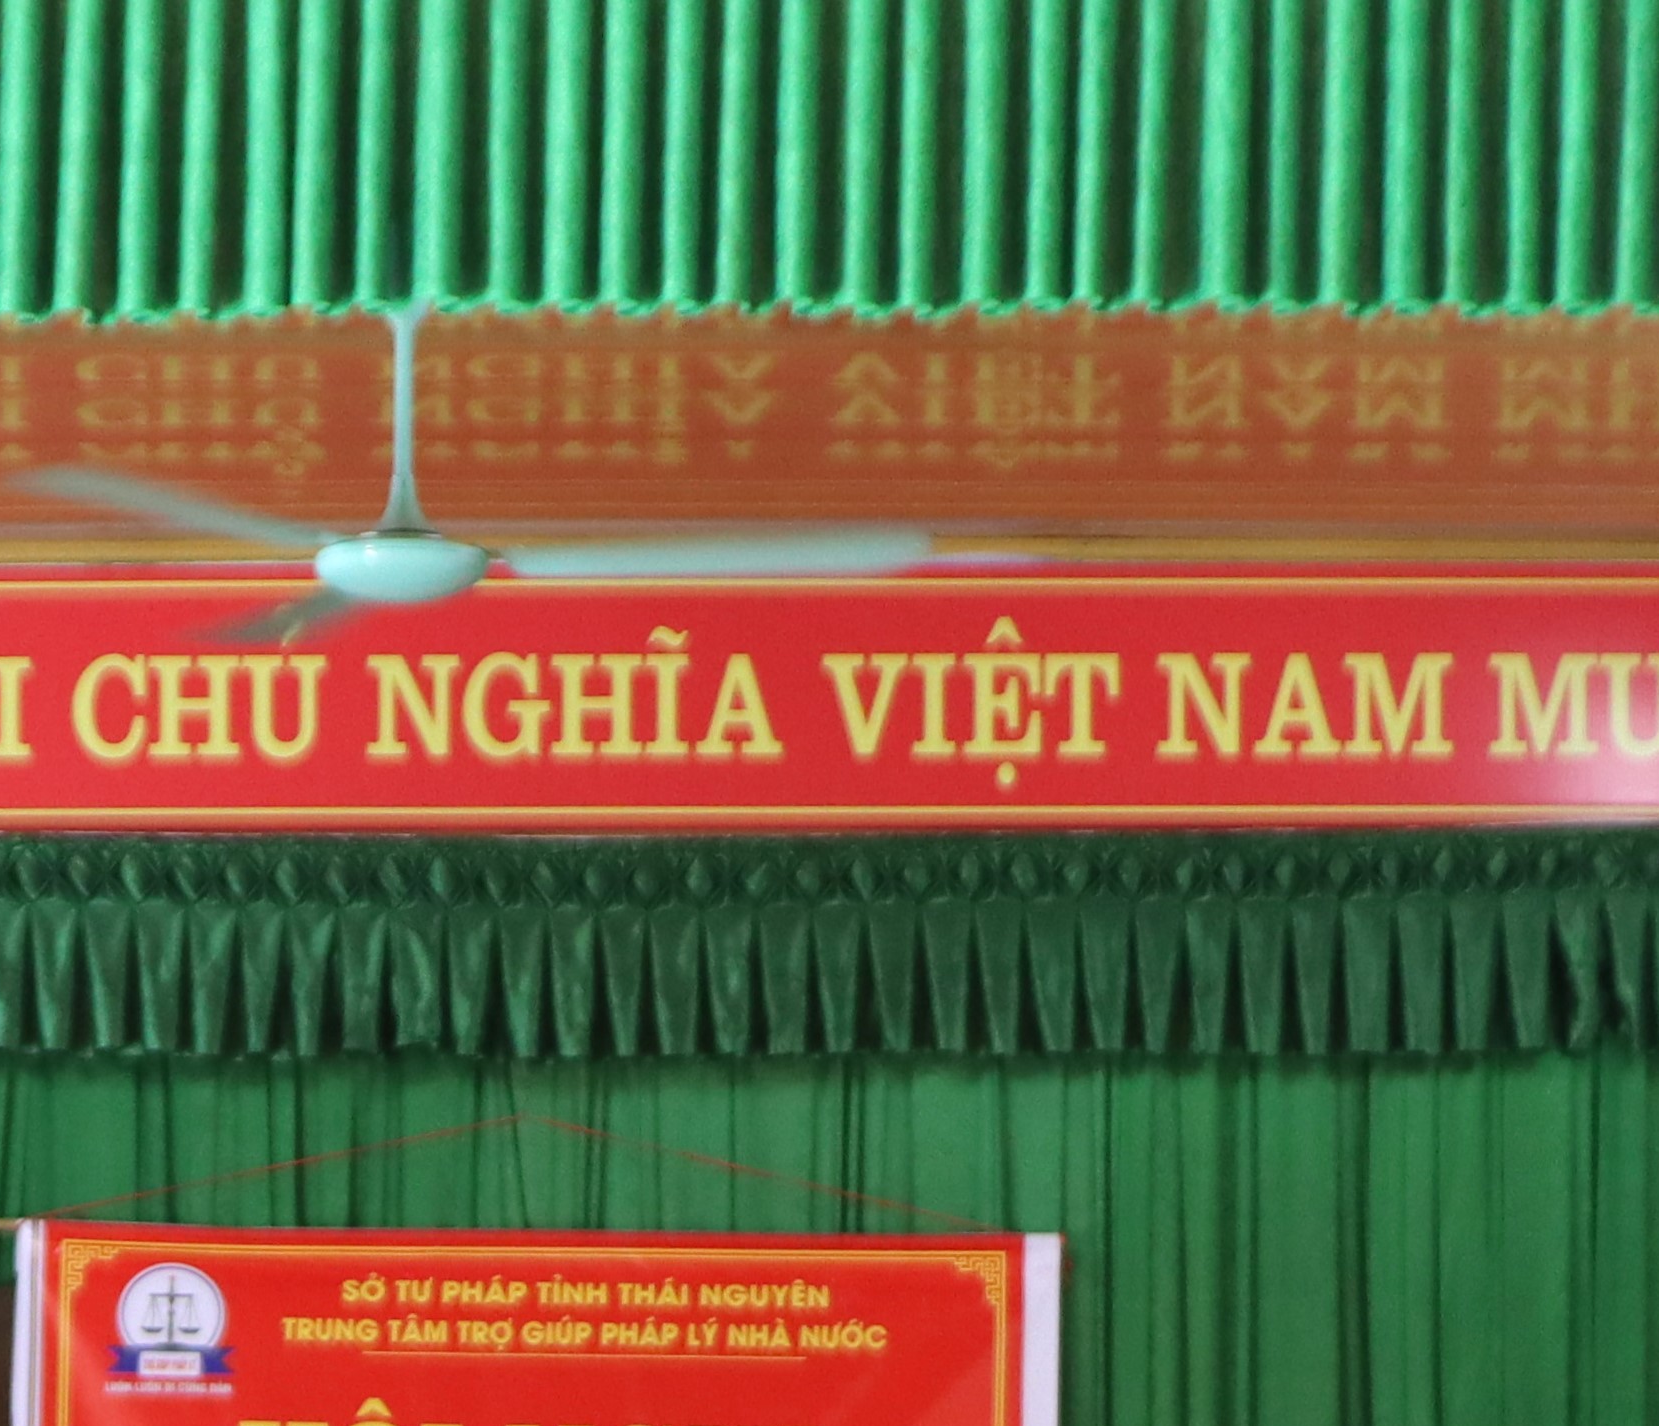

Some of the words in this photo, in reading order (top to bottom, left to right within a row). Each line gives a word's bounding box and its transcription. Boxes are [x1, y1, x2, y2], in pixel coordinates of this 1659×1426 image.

[367, 626, 782, 760] NGHĨA
[823, 616, 1121, 786] VIỆT
[1157, 652, 1454, 758] NAM
[342, 1271, 386, 1302] SỞ
[395, 1276, 434, 1303] TƯ
[441, 1274, 528, 1304] PHÁP
[537, 1273, 608, 1305] TỈNH
[618, 1276, 689, 1306] THÁI
[699, 1278, 831, 1308] NGUYÊN
[282, 1316, 380, 1342] TRUNG
[387, 1313, 449, 1343] TÂM
[456, 1317, 513, 1351] TRỢ
[521, 1314, 592, 1345] GIÚP
[600, 1315, 680, 1346] PHÁP
[687, 1316, 719, 1346] LÝ
[728, 1317, 792, 1347] NHÀ
[800, 1318, 888, 1349] NƯỚC
